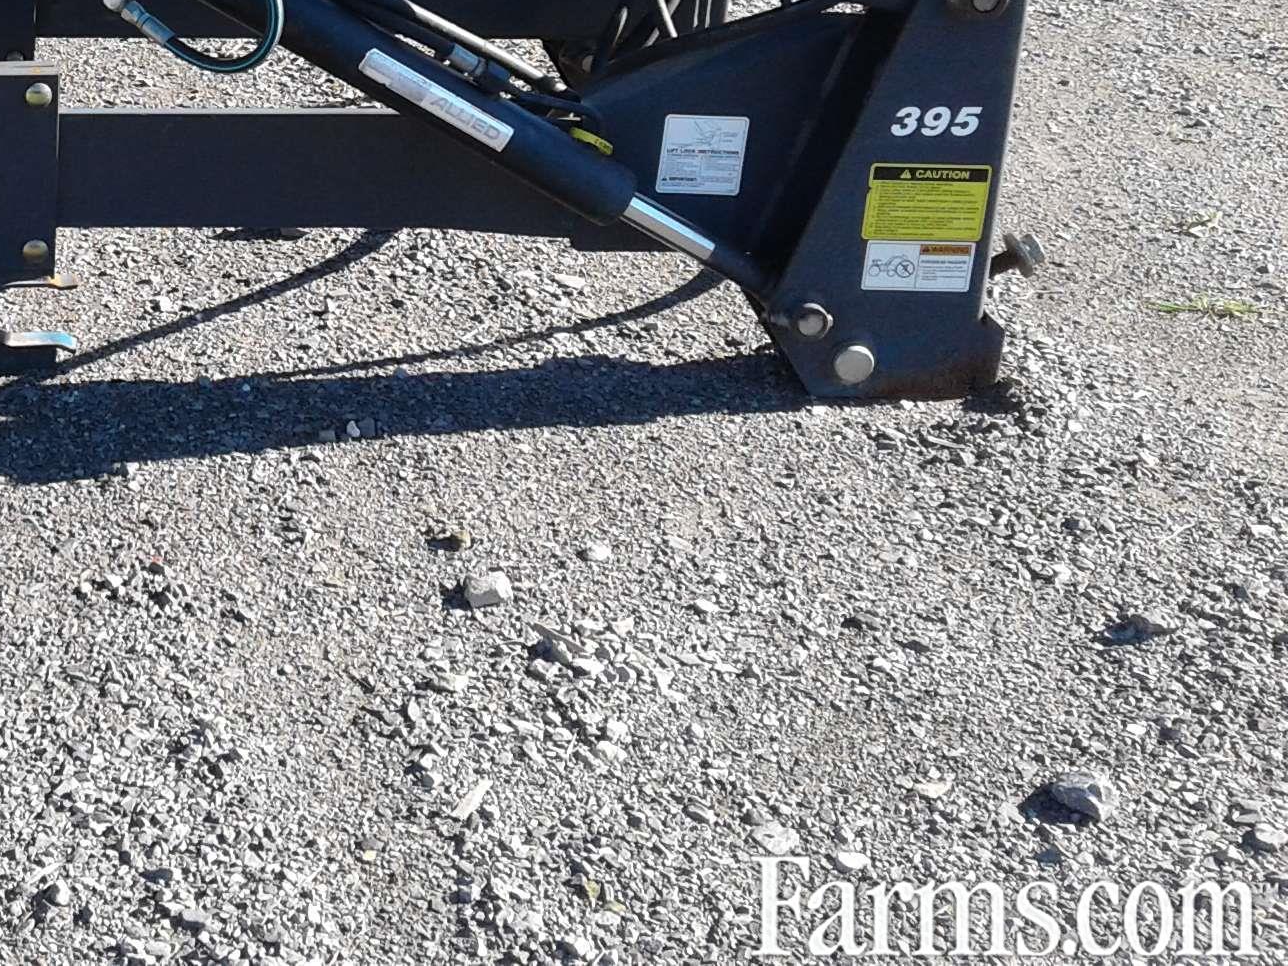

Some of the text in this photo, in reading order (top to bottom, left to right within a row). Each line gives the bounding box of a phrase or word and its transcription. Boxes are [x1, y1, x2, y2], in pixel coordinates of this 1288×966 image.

[430, 97, 501, 141] ALLIED
[890, 106, 983, 137] 395
[915, 169, 970, 180] CAUTION
